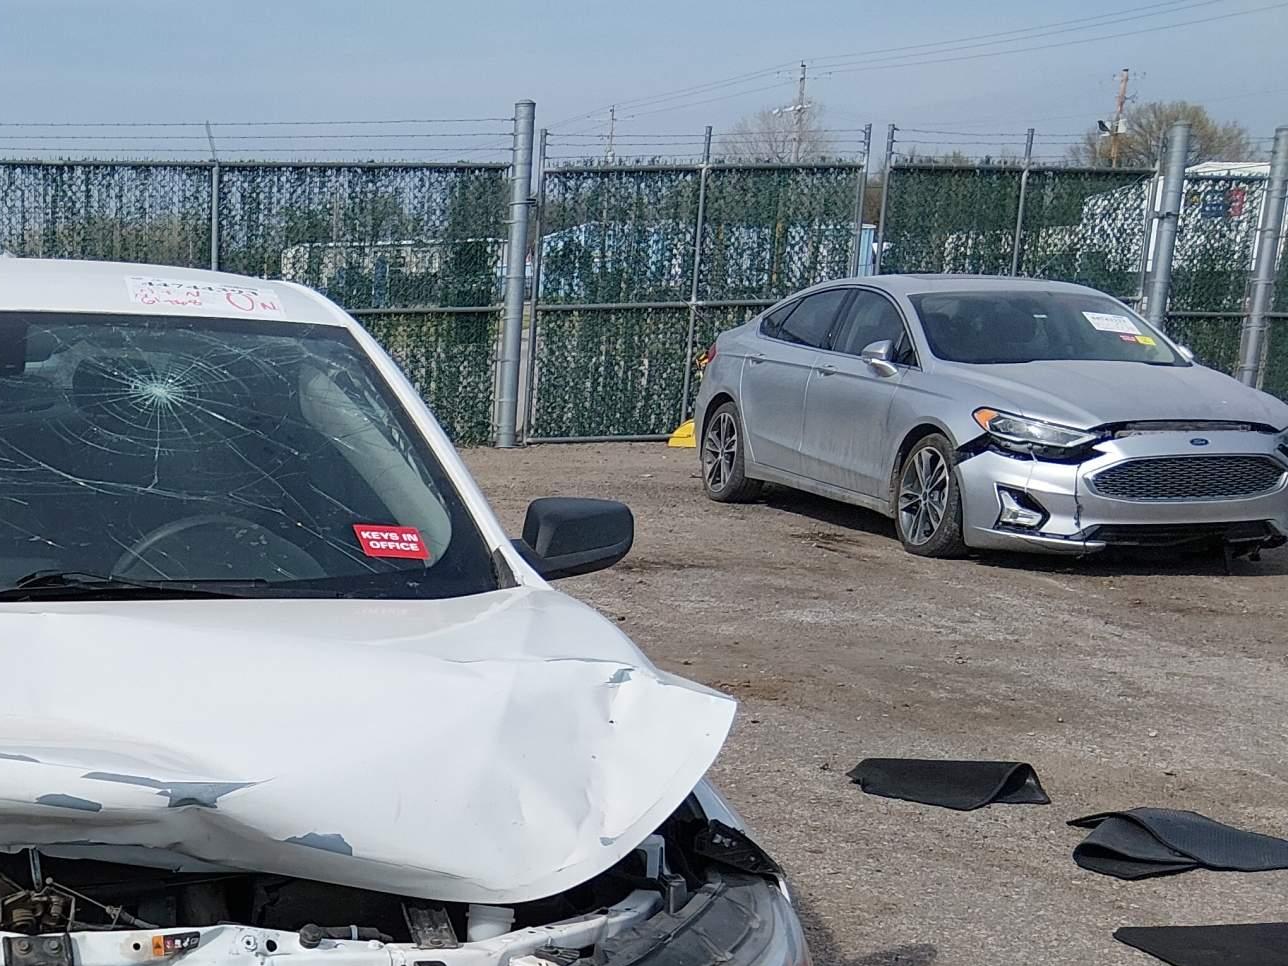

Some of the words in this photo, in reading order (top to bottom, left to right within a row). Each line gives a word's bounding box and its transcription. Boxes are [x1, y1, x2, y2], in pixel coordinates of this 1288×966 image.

[361, 531, 399, 541] KEYS
[402, 533, 419, 542] IN
[369, 540, 420, 552] OFFICE
